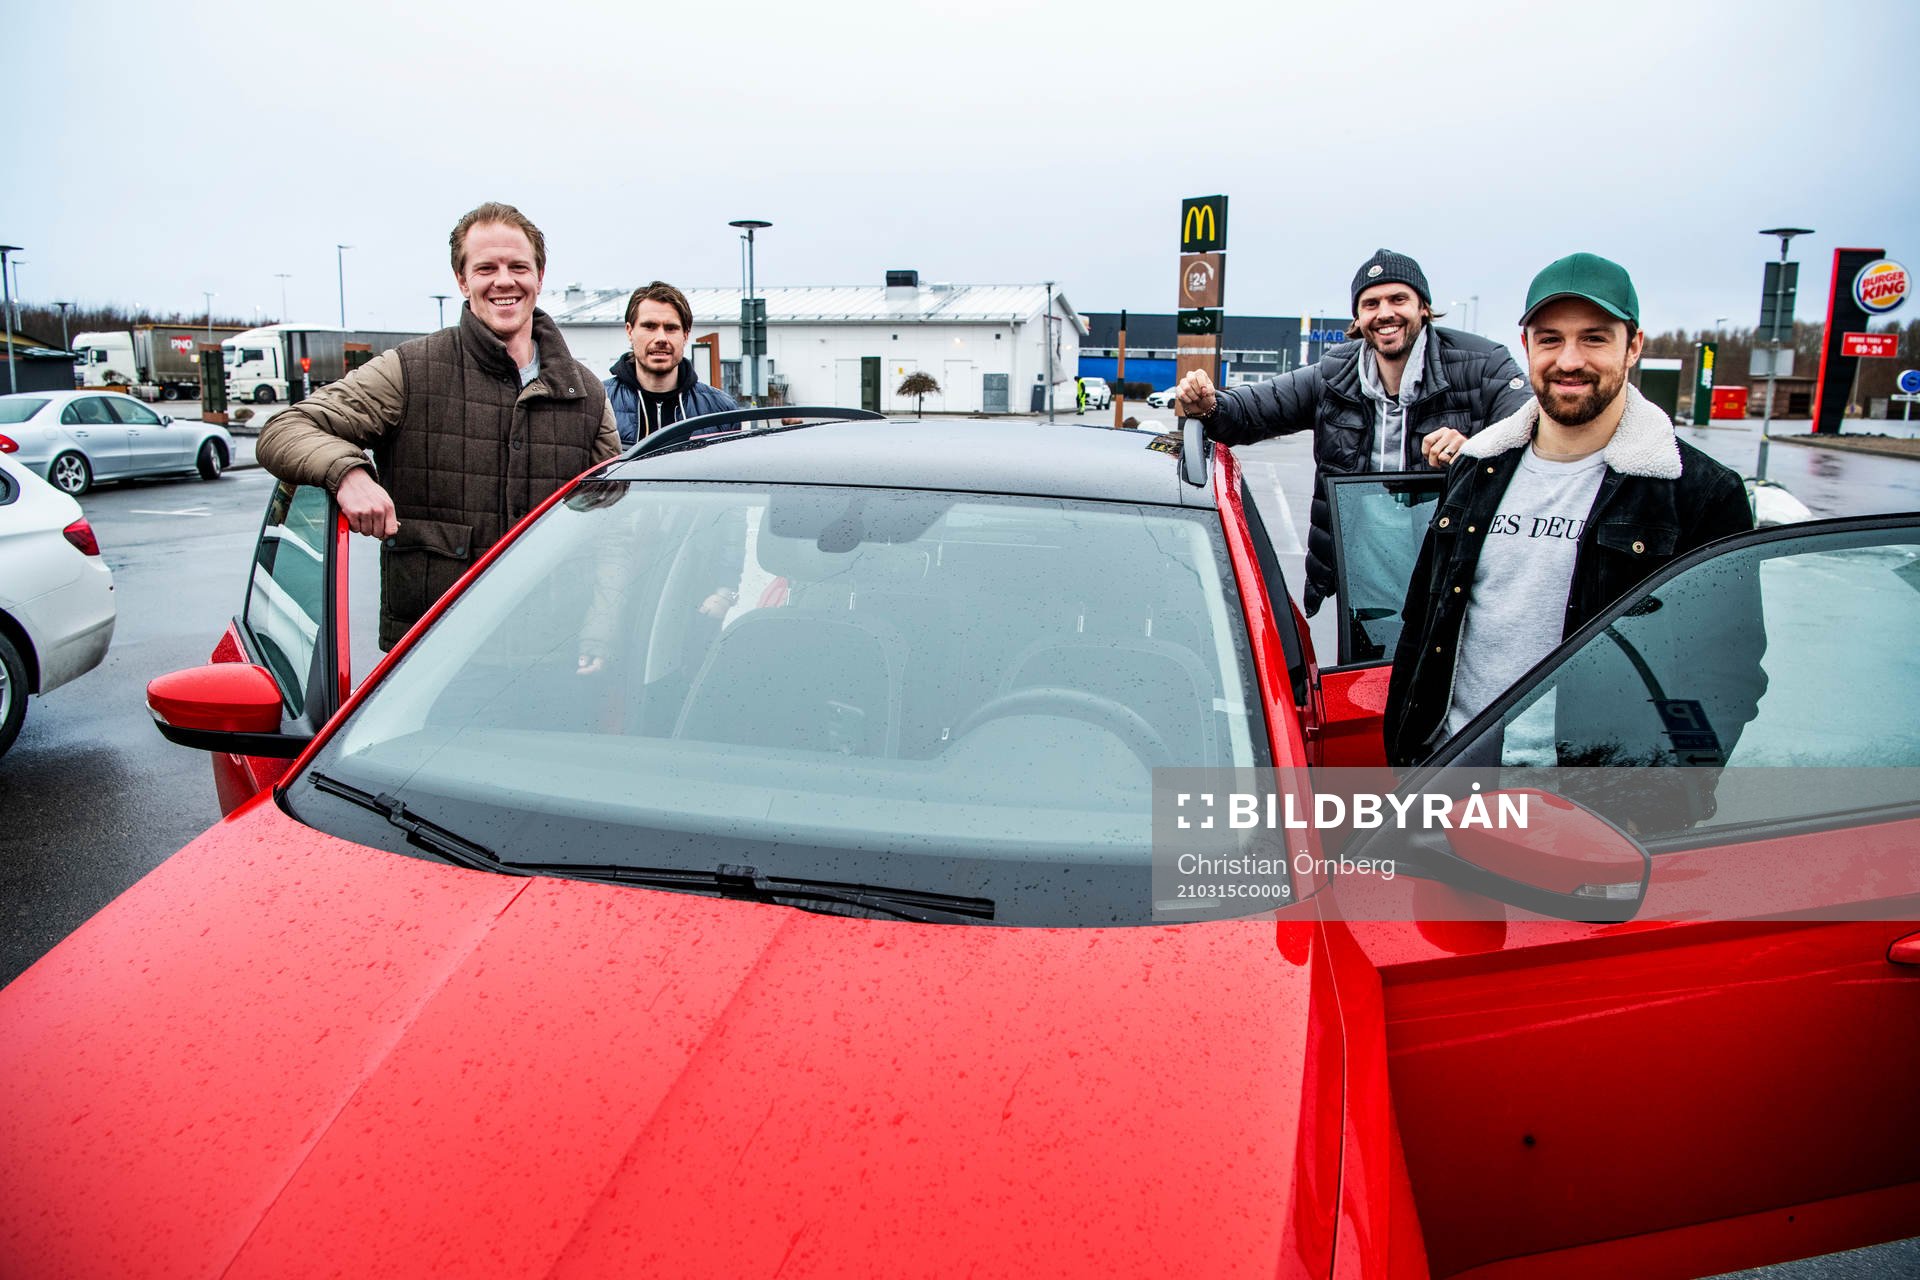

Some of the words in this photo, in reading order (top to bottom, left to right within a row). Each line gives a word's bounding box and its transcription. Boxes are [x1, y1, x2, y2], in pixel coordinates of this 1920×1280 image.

[1193, 272, 1206, 286] 24
[1863, 271, 1905, 288] BURGER
[1862, 280, 1905, 302] KING
[171, 339, 194, 350] PNO
[1487, 514, 1521, 535] ES
[1528, 516, 1585, 540] DEU
